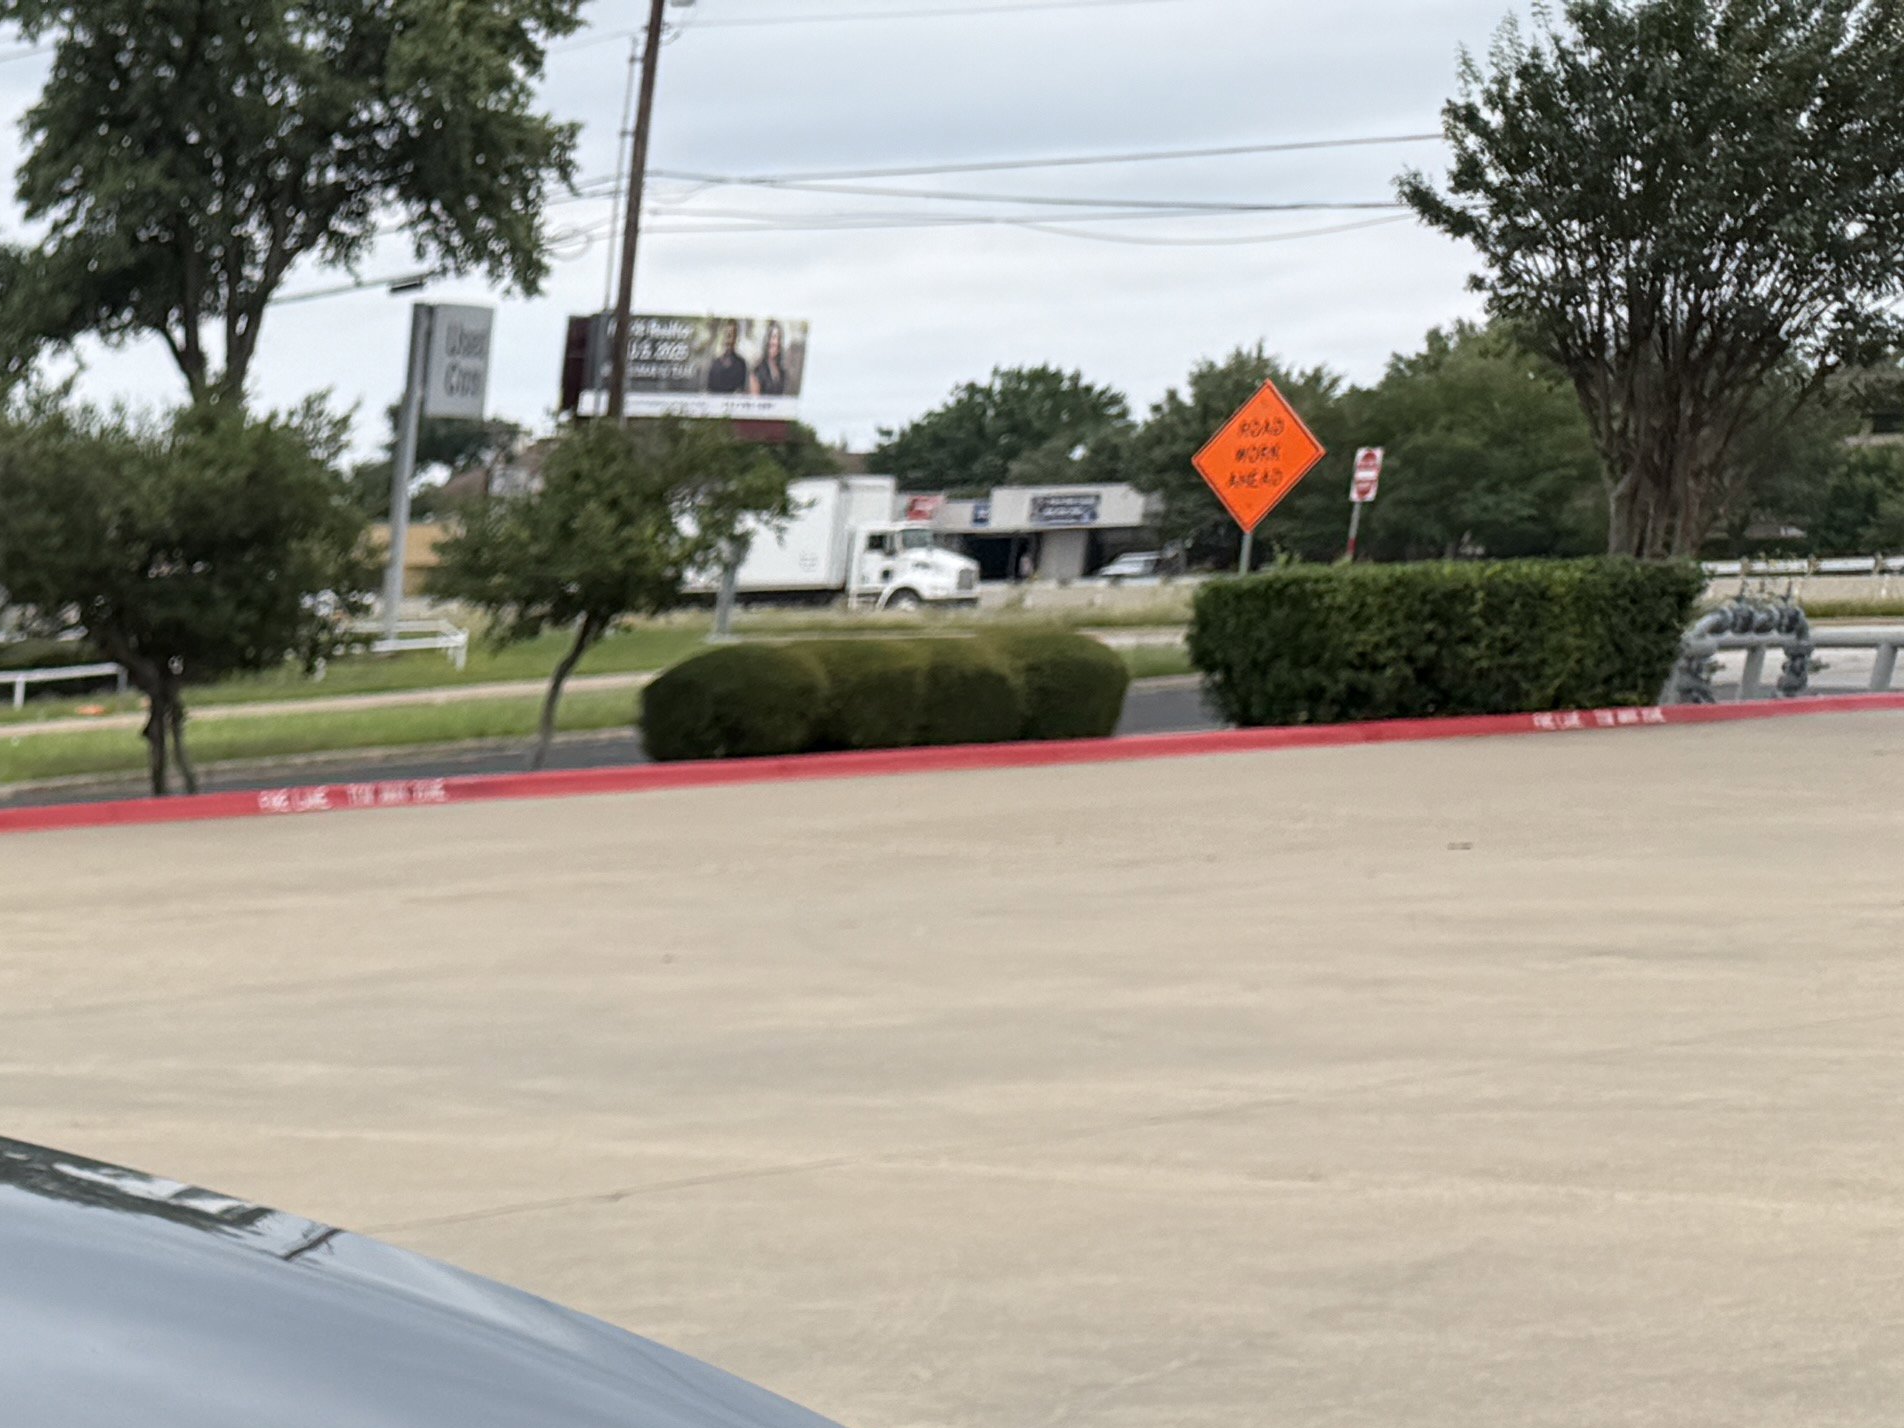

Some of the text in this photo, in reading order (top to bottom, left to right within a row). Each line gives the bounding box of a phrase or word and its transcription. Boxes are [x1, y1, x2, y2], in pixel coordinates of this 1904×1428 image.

[1238, 418, 1285, 438] ROAD
[1234, 447, 1282, 464] WORK
[1227, 467, 1284, 489] AHEAD
